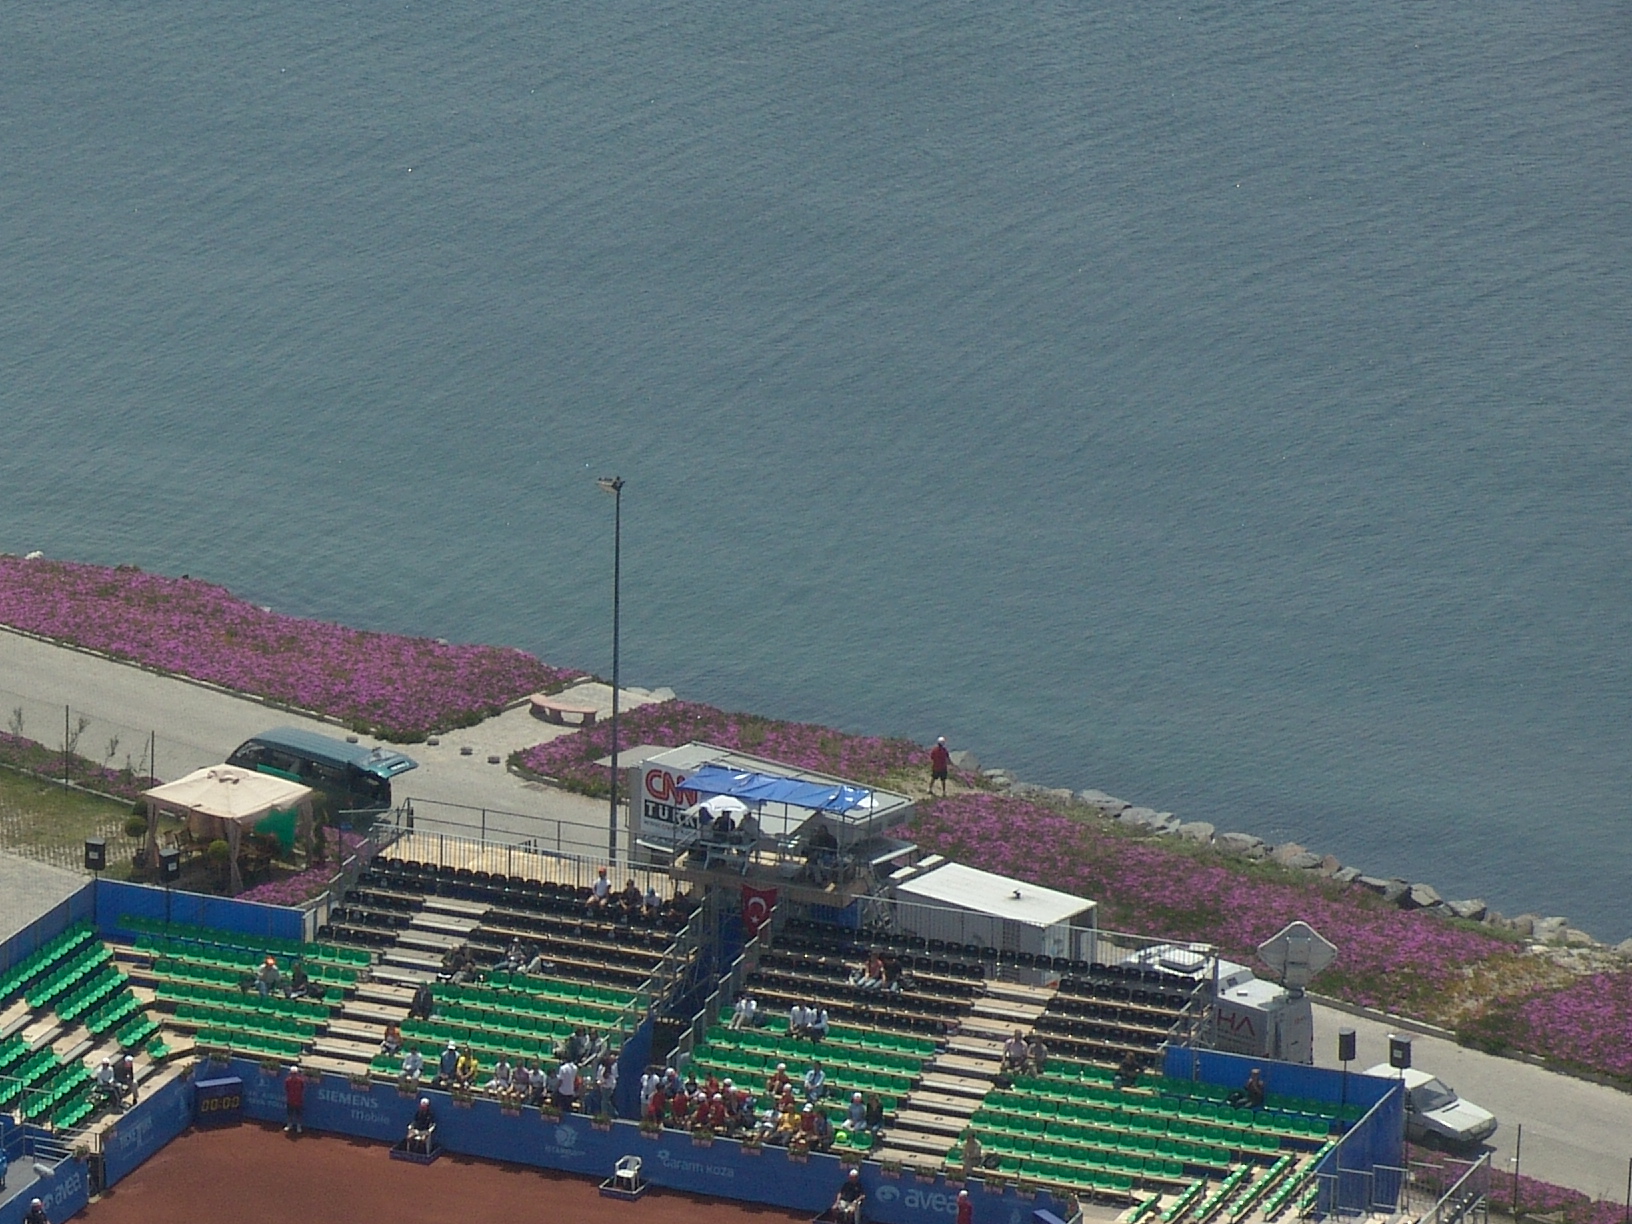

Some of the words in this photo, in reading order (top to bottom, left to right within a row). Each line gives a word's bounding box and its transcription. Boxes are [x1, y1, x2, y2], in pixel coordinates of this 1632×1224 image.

[645, 768, 698, 807] CNN
[201, 1096, 241, 1112] 00:00
[317, 1088, 379, 1109] SIEMENS
[54, 1171, 82, 1206] avea
[904, 1188, 959, 1215] avea
